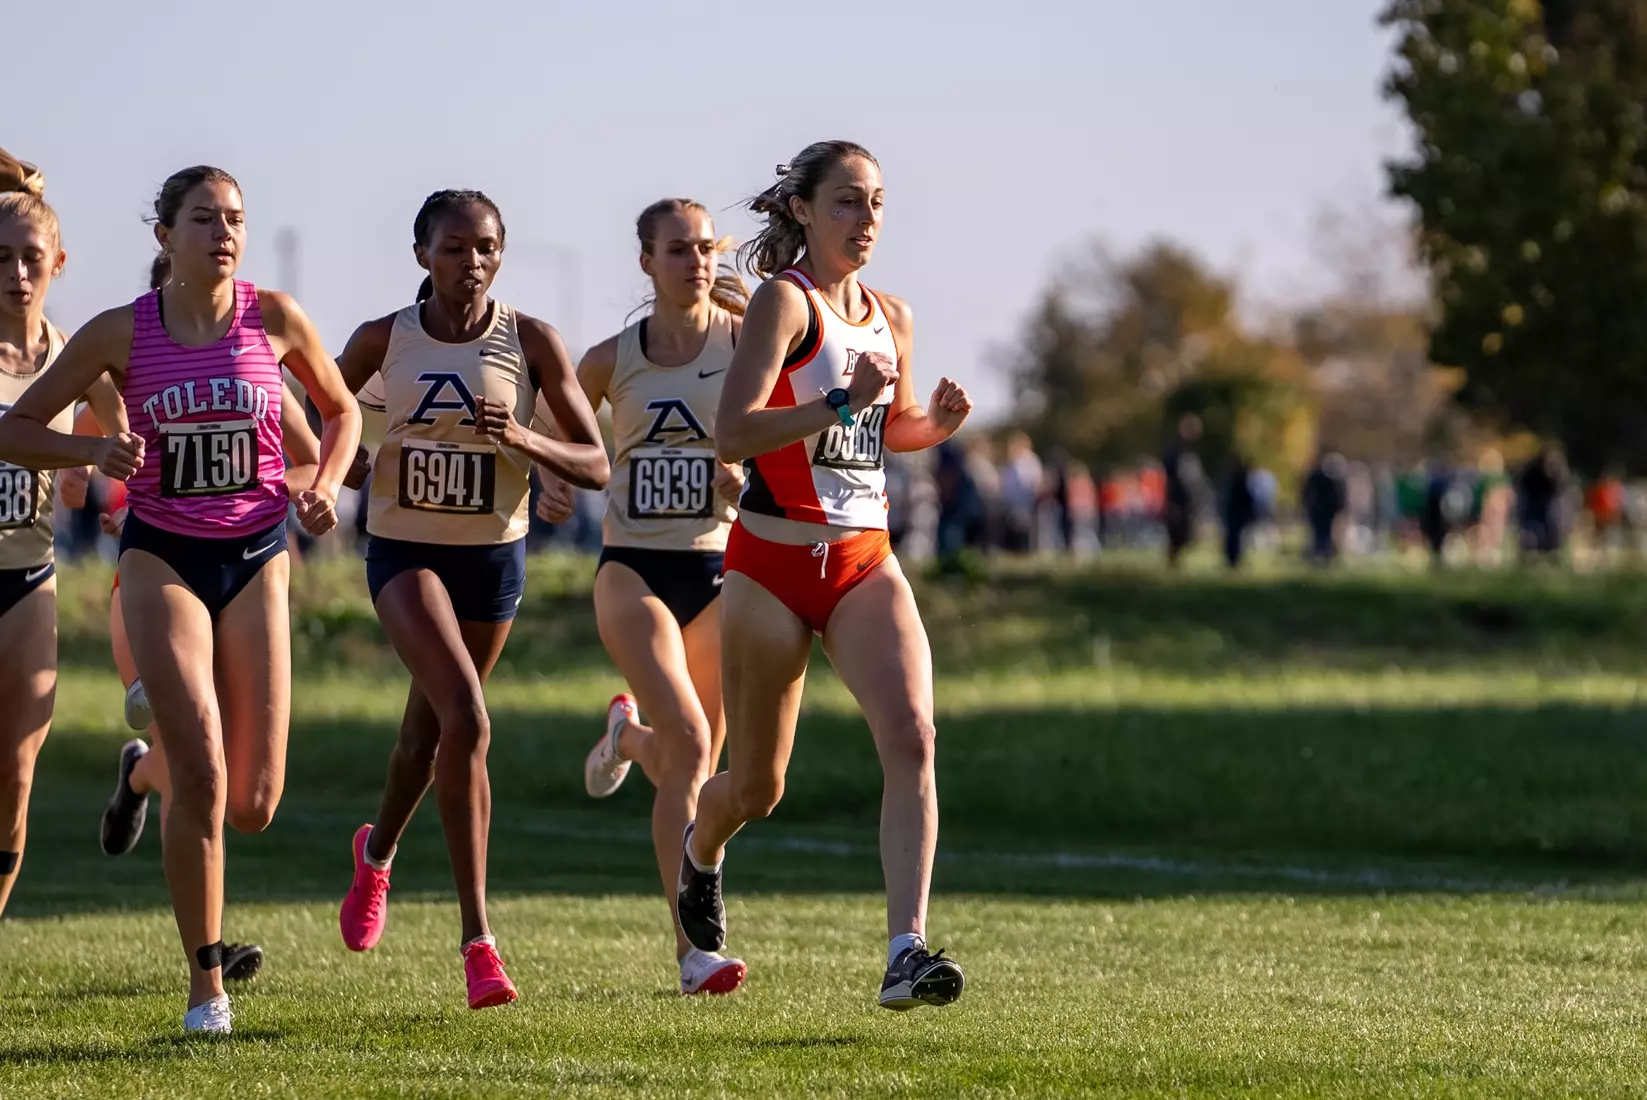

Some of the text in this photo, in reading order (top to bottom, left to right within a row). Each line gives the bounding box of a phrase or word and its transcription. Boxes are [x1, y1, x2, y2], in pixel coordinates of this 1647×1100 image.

[142, 378, 269, 431] TOLEDO
[408, 372, 478, 427] A
[643, 398, 709, 443] A
[167, 431, 251, 489] 7150
[407, 450, 484, 506] 6941
[635, 459, 708, 511] 6939
